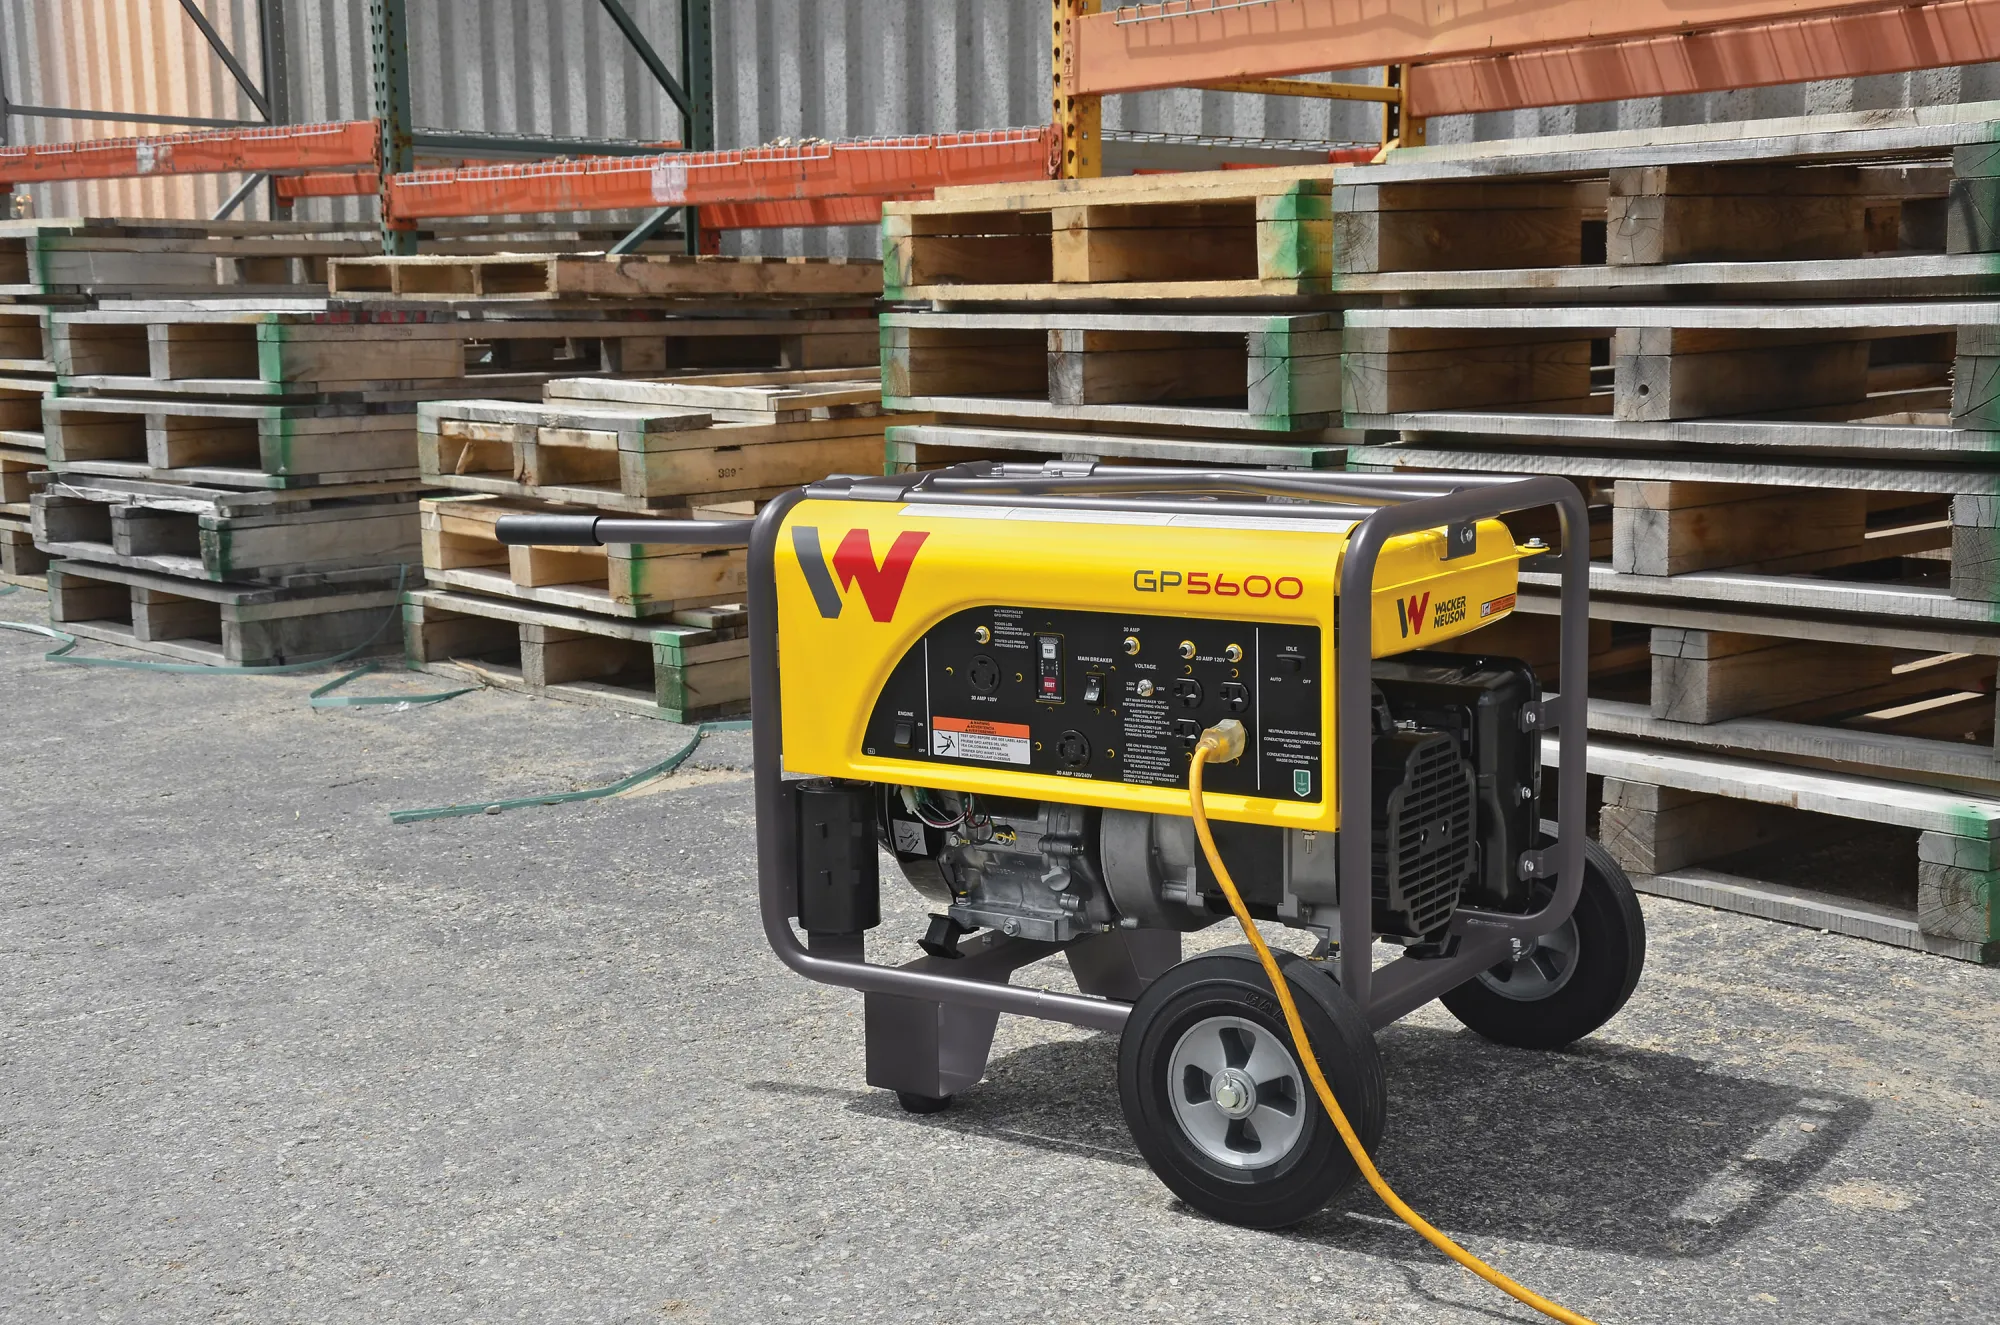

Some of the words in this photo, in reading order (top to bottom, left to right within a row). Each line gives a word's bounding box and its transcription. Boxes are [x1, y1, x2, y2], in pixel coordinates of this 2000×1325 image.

[1134, 570, 1303, 600] GP5600
[1435, 596, 1466, 615] WACKER
[1434, 608, 1466, 628] NEUSON
